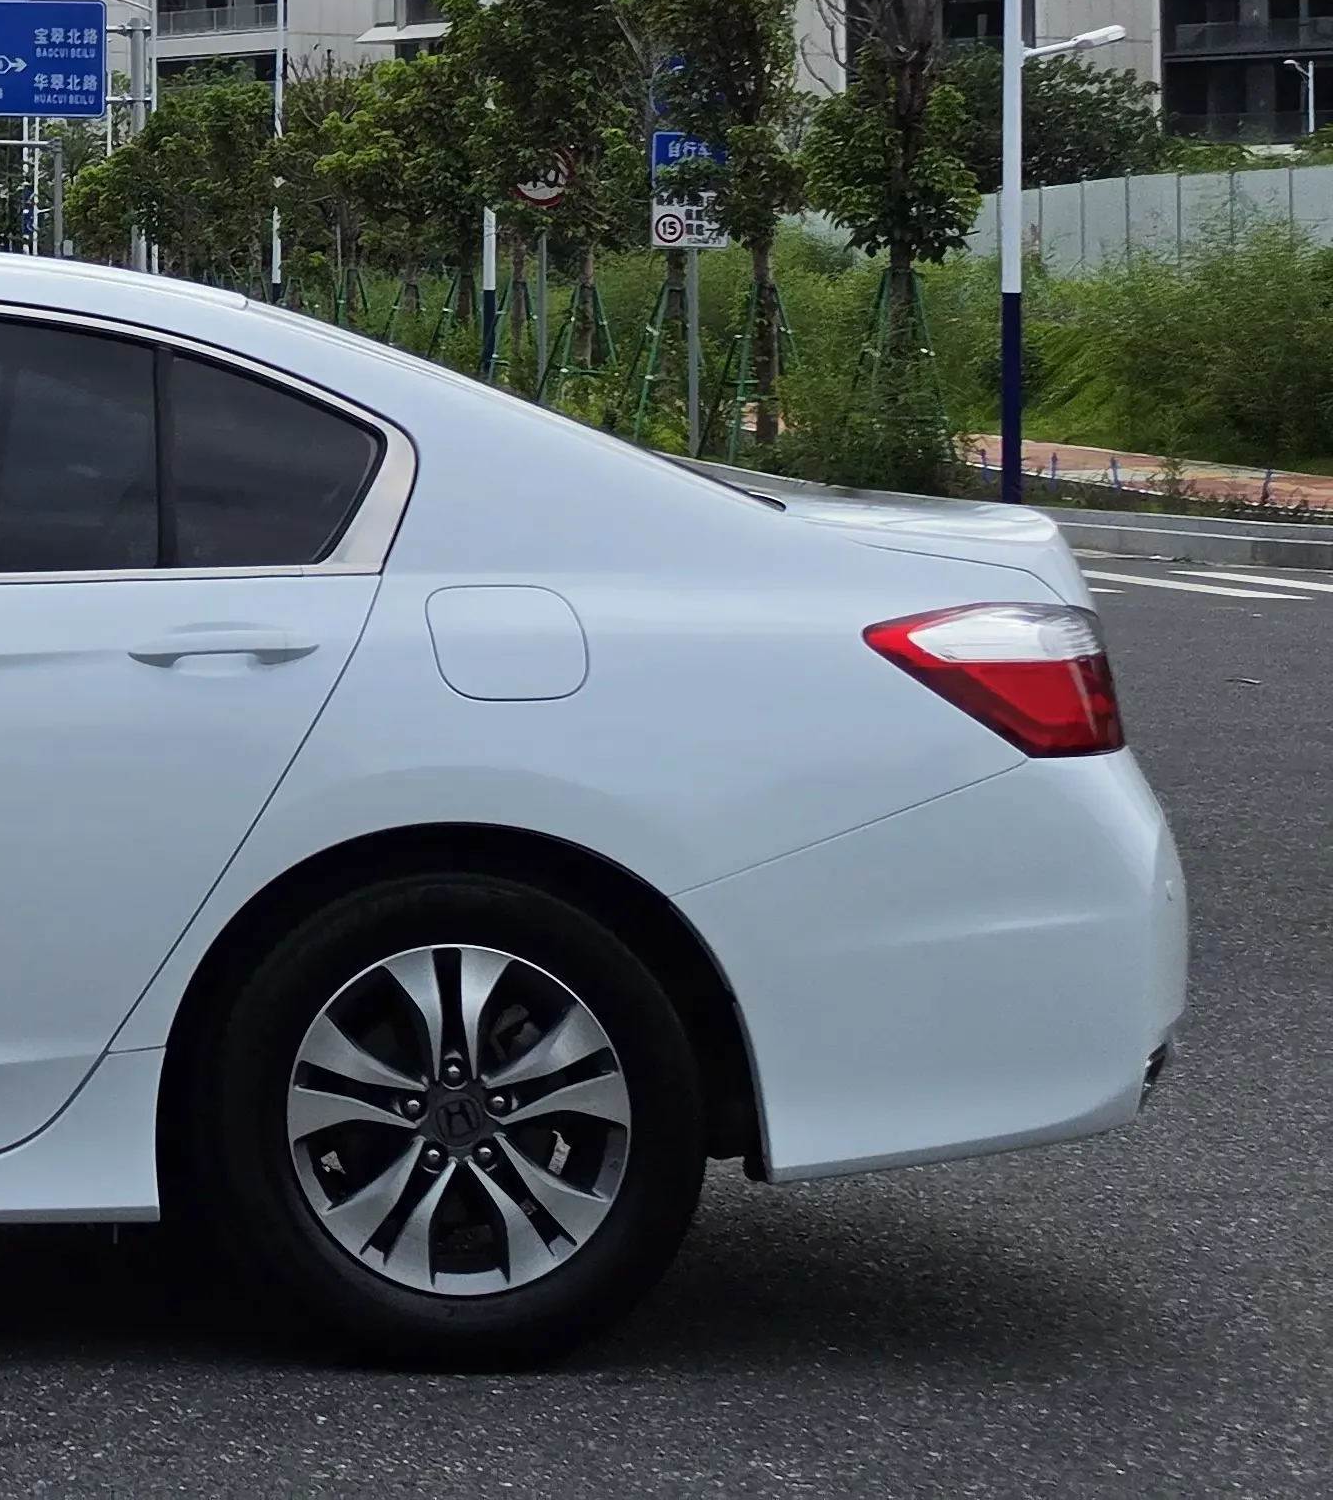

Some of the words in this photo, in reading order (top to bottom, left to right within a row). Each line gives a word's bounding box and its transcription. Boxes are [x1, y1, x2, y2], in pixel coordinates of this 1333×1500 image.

[33, 27, 98, 45] 宝翠北路
[33, 73, 98, 91] 华翠北路
[668, 140, 712, 158] 自行车
[661, 220, 677, 236] 15
